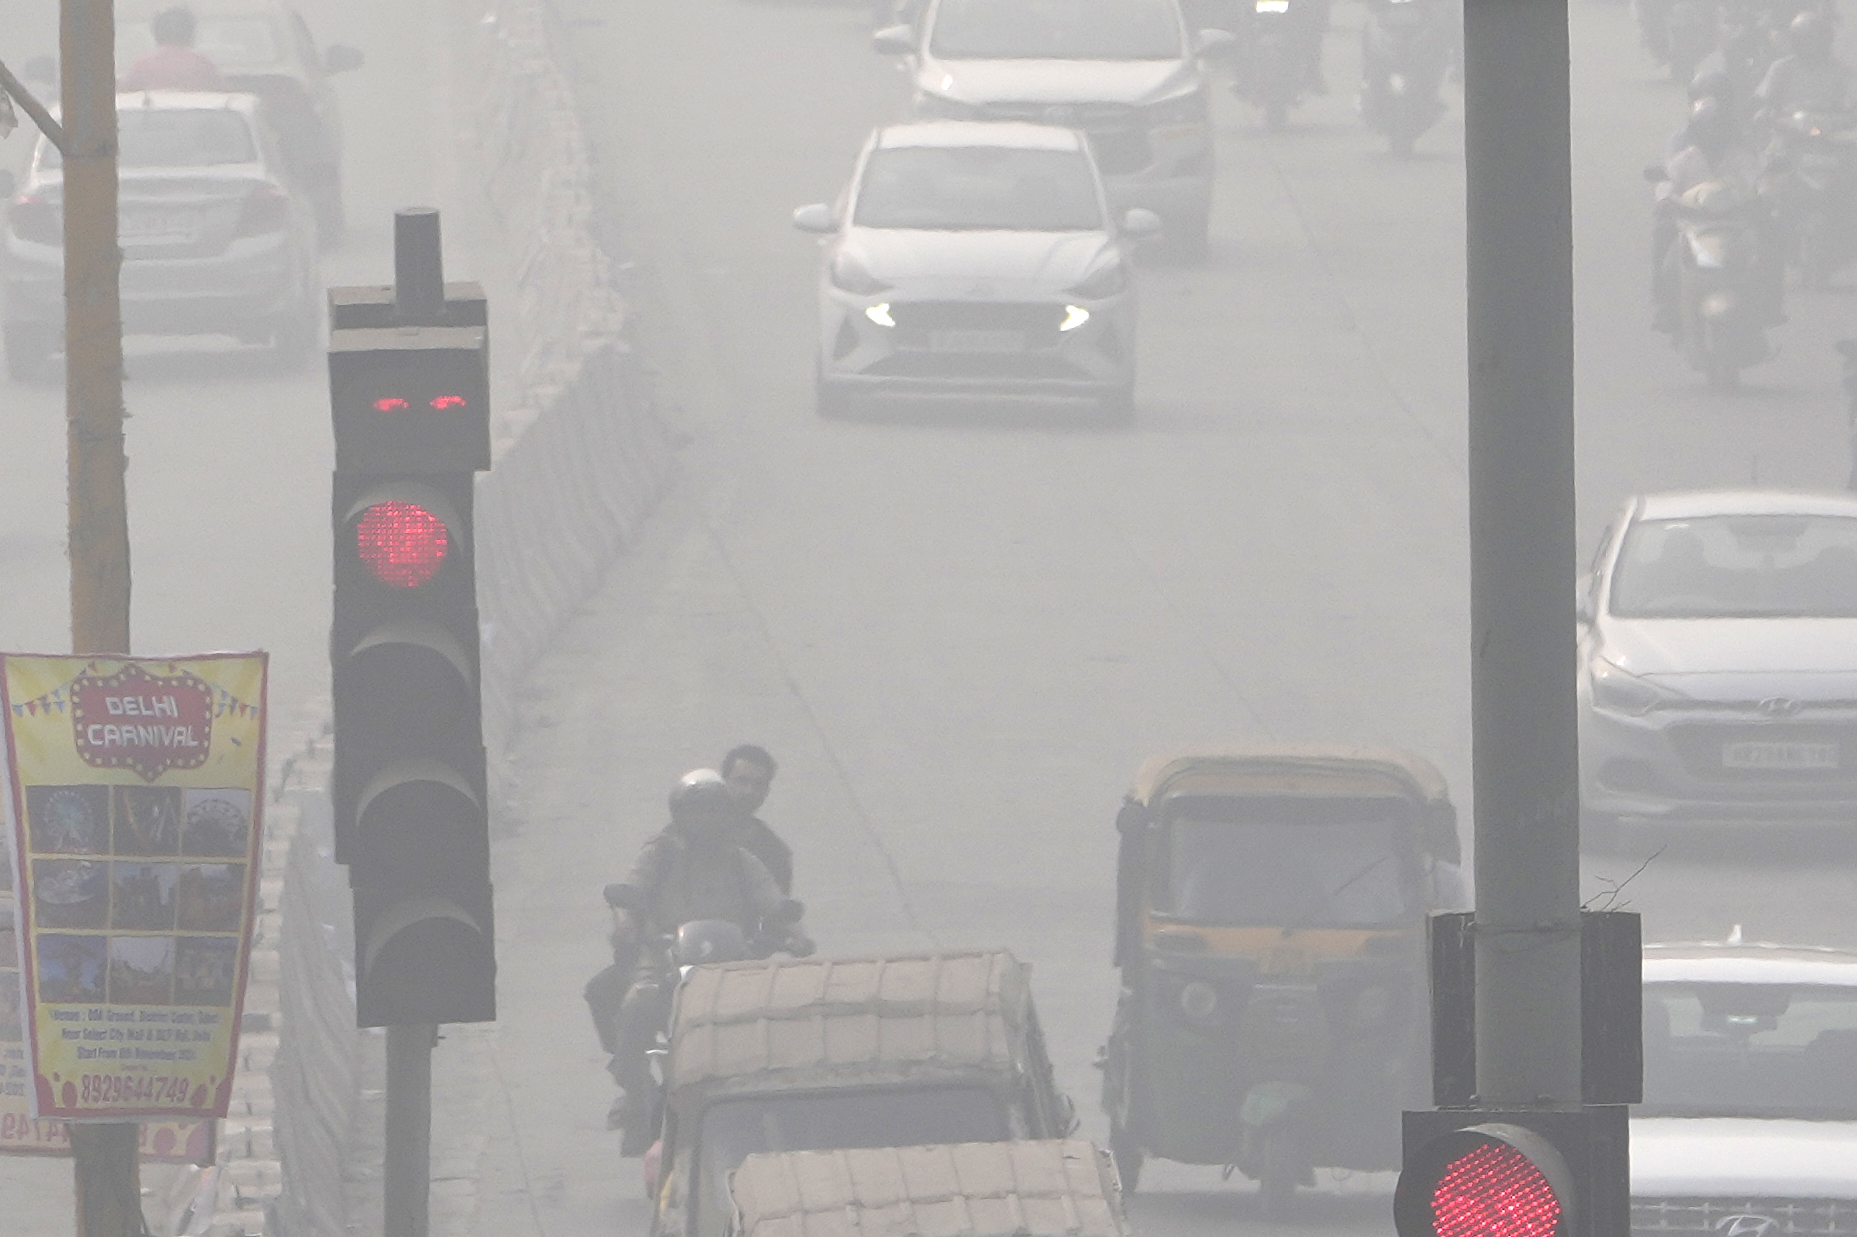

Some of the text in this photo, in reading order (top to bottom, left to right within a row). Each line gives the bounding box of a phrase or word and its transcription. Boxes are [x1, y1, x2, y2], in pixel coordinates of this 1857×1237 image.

[105, 695, 179, 718] DELHI
[87, 723, 199, 748] CARNIVAL
[81, 1073, 190, 1104] 8929644749
